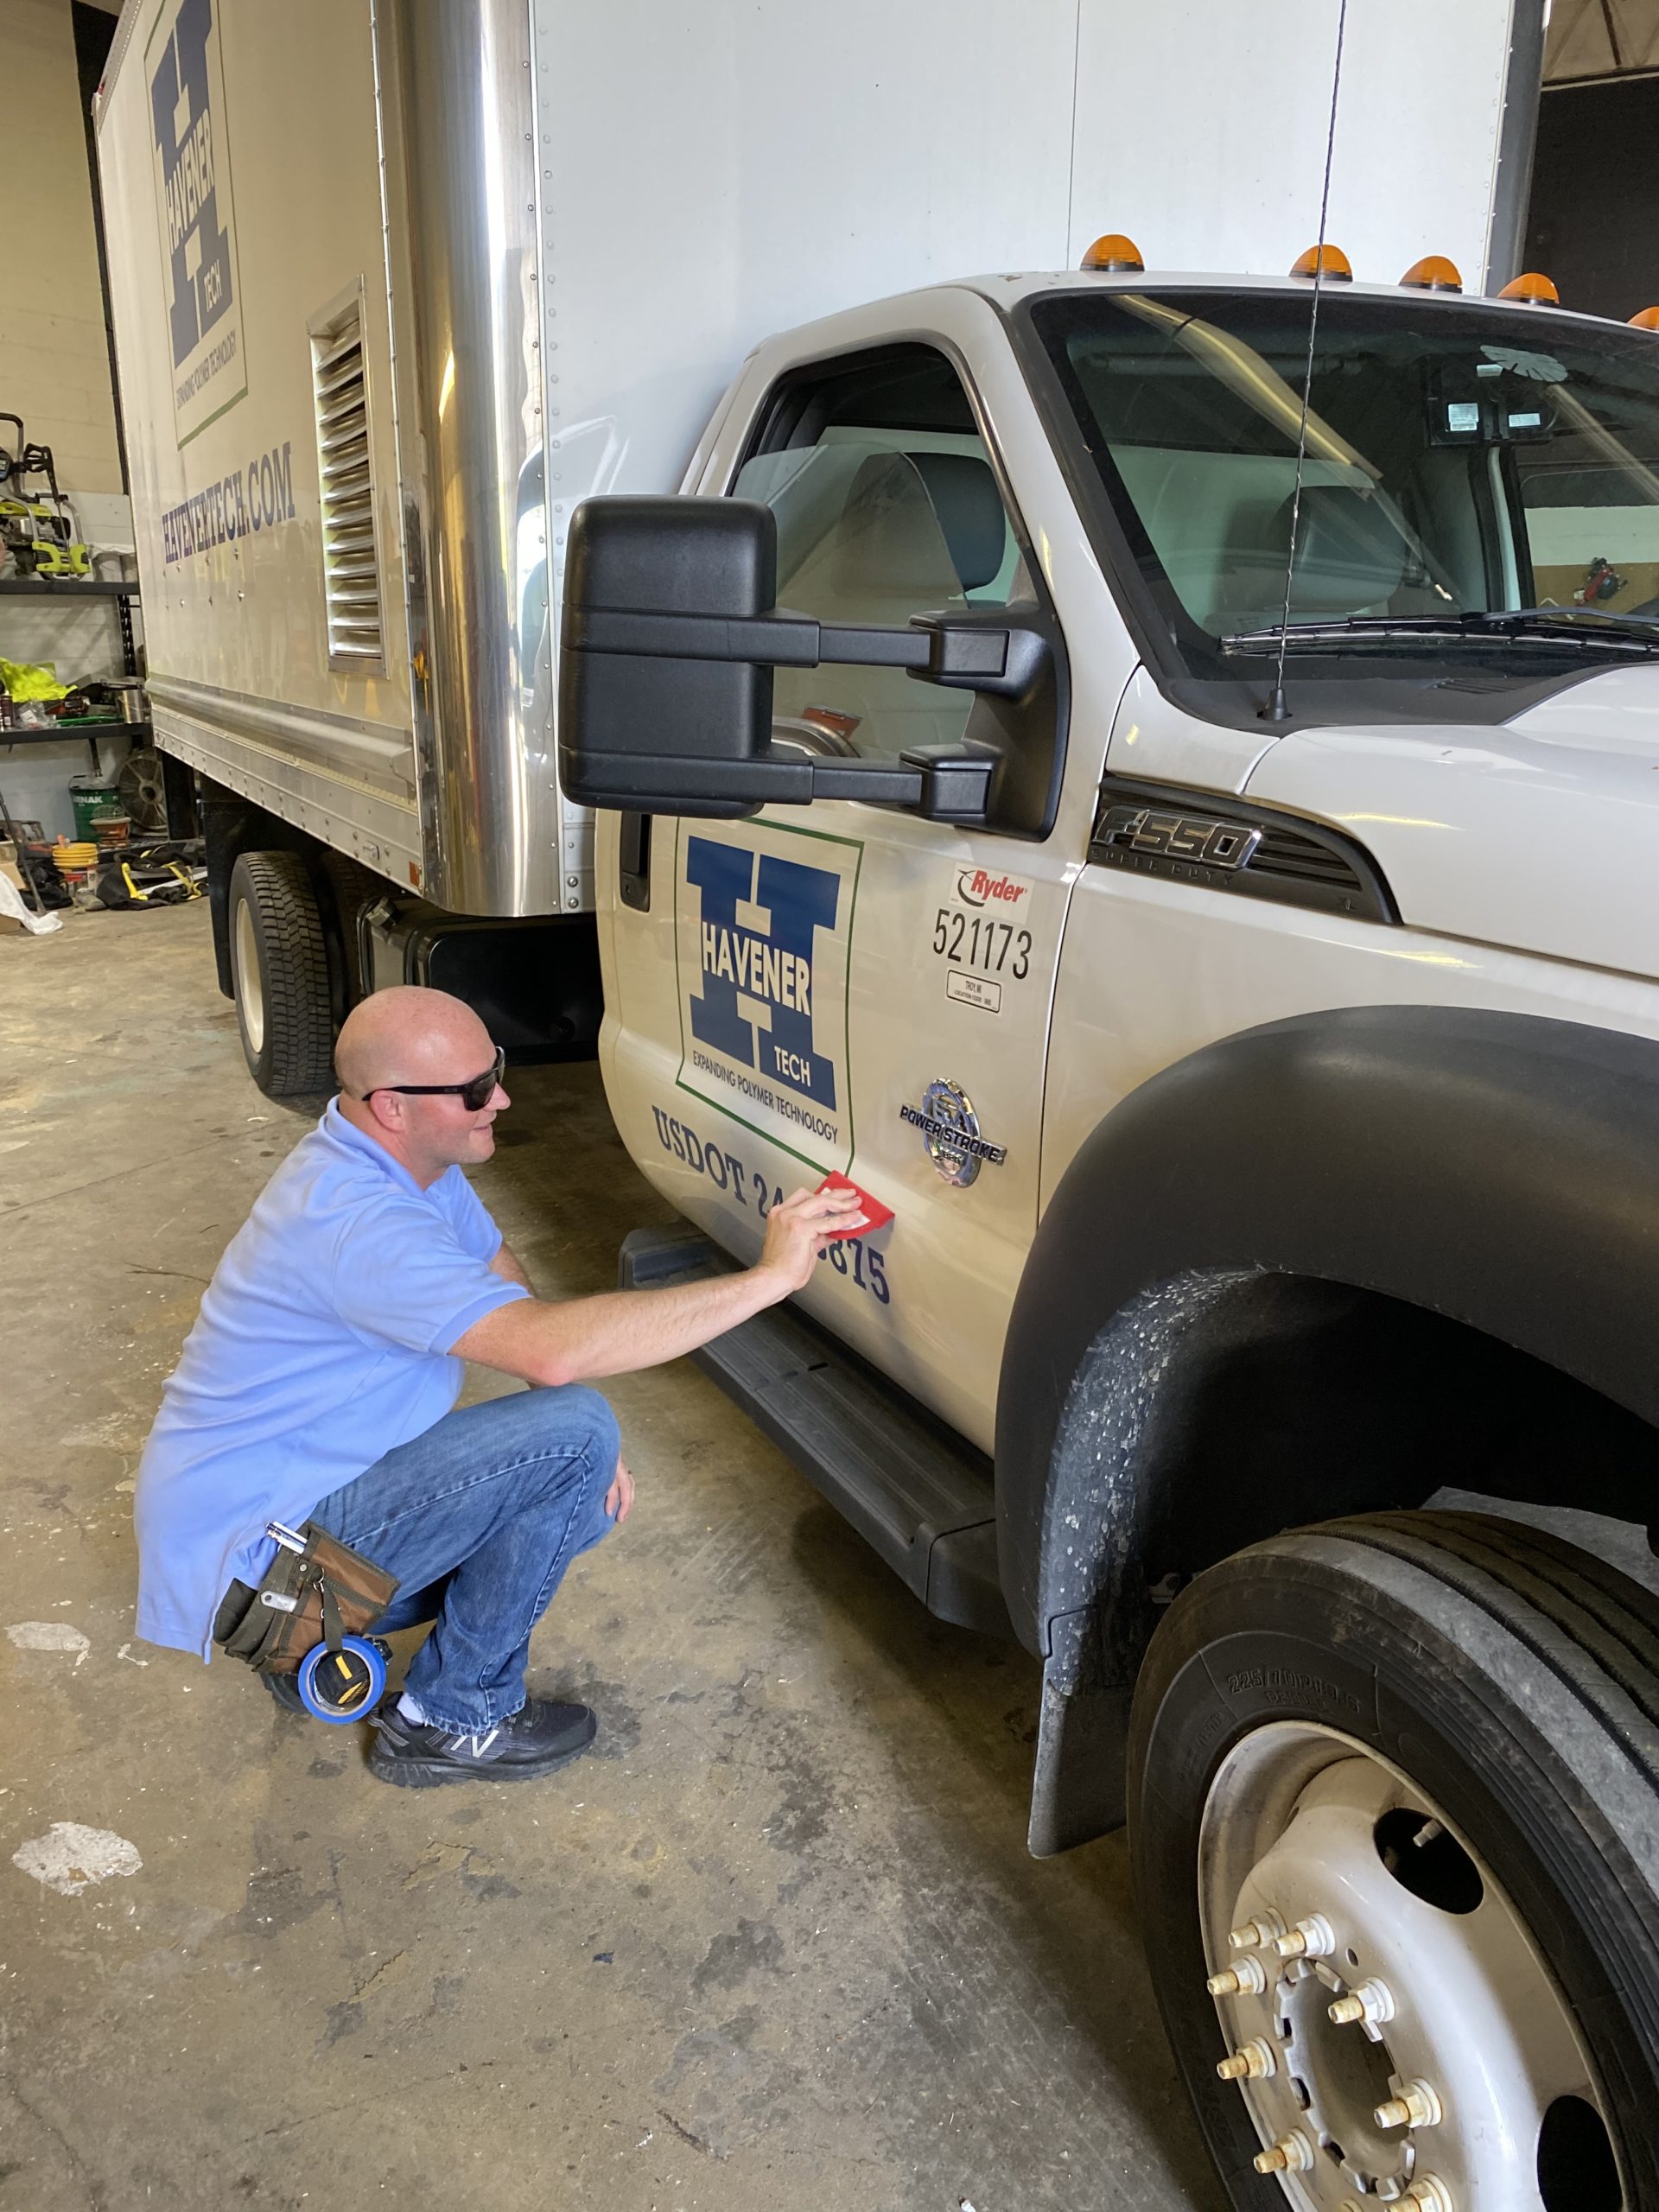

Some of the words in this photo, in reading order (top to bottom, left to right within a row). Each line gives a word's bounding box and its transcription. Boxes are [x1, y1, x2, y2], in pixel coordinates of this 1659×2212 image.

[166, 108, 215, 257] HAVENER
[204, 259, 223, 313] TECH
[162, 442, 296, 565] HAVENERTECH.COM
[970, 870, 1025, 903] Ryder
[1172, 863, 1233, 886] DUTY
[702, 921, 810, 1017] HAVENER
[933, 908, 1032, 979] 521173
[693, 1051, 736, 1087] EXPANDING
[737, 1075, 774, 1109] POLYMER
[775, 1095, 838, 1144] TECHNOLOGY
[773, 1046, 811, 1087] TECH
[652, 1104, 747, 1206] USDOT
[899, 1105, 942, 1138] POWER
[943, 1127, 1001, 1163] STROKE
